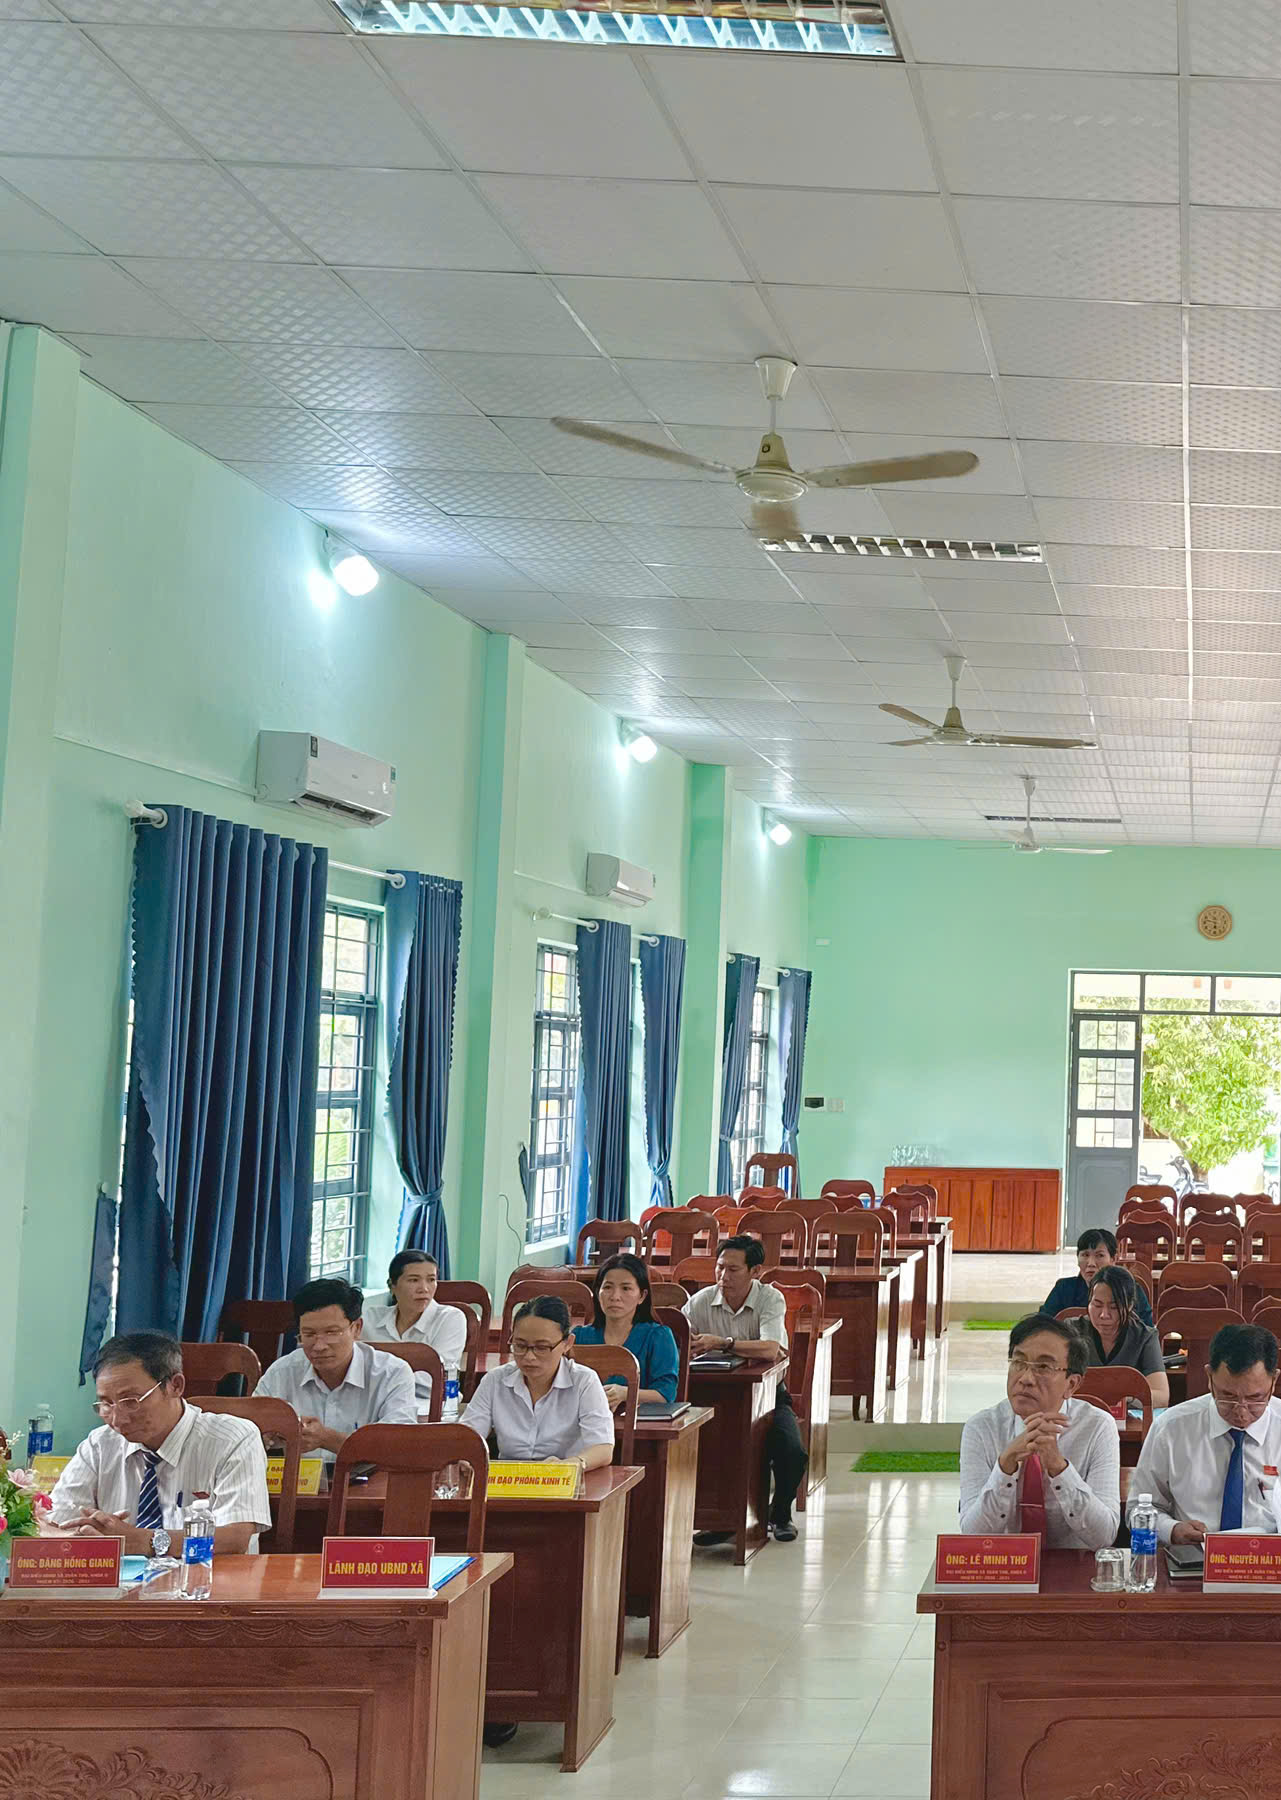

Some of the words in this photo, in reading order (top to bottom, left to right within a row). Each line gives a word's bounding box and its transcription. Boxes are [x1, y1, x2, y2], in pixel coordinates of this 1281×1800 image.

[497, 1476, 513, 1486] ĐẠO
[514, 1474, 540, 1485] PHÒNG
[541, 1477, 560, 1485] KINH
[17, 1556, 38, 1569] ÔNG:
[89, 1558, 115, 1569] GIANG
[946, 1553, 968, 1565] ÔNG:
[970, 1553, 981, 1565] LÊ
[983, 1555, 1008, 1565] MINH
[1010, 1554, 1028, 1565] THƠ
[1209, 1553, 1228, 1564] ÔNG:
[1260, 1551, 1273, 1565] HẢI
[328, 1560, 355, 1575] LÃNH
[357, 1562, 378, 1577] ĐẠO
[380, 1562, 408, 1575] UBND
[410, 1560, 424, 1575] XÃ
